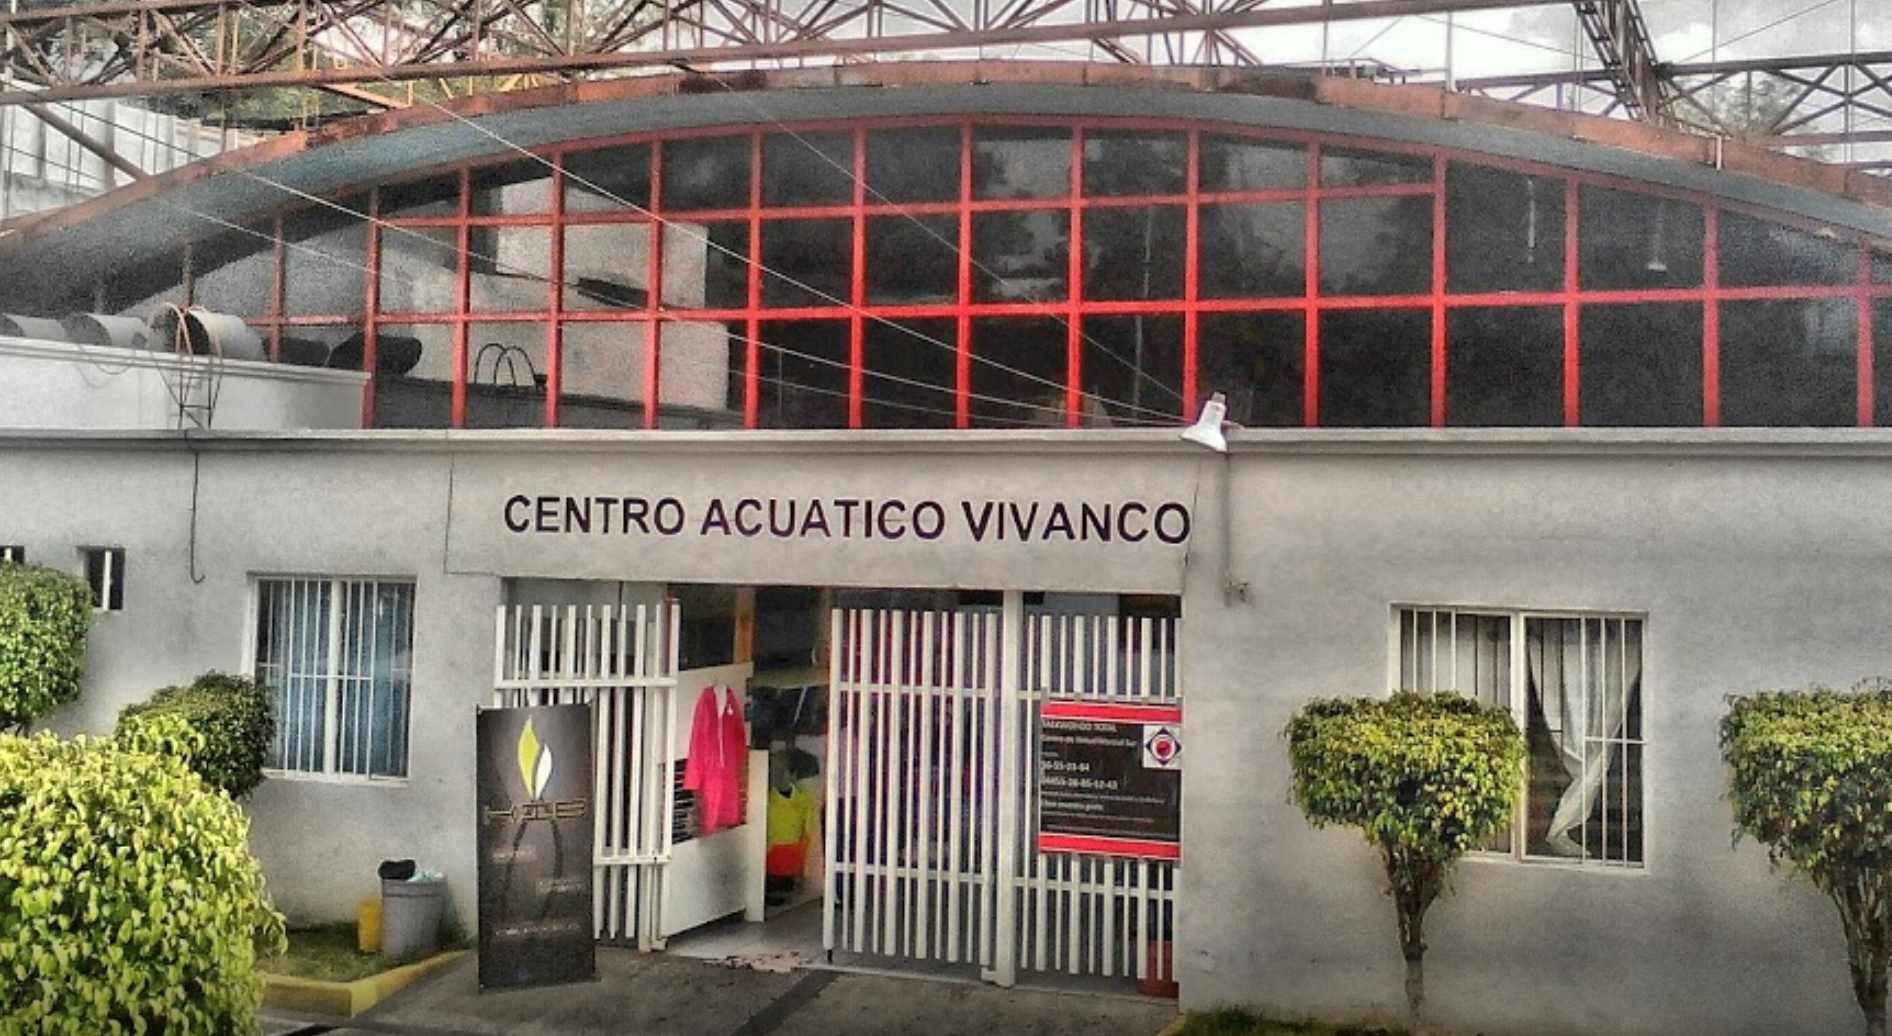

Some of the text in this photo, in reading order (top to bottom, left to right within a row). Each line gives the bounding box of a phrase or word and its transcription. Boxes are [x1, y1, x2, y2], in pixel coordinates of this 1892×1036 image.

[504, 494, 1191, 544] CENTRO ACUATICO VIVANCO
